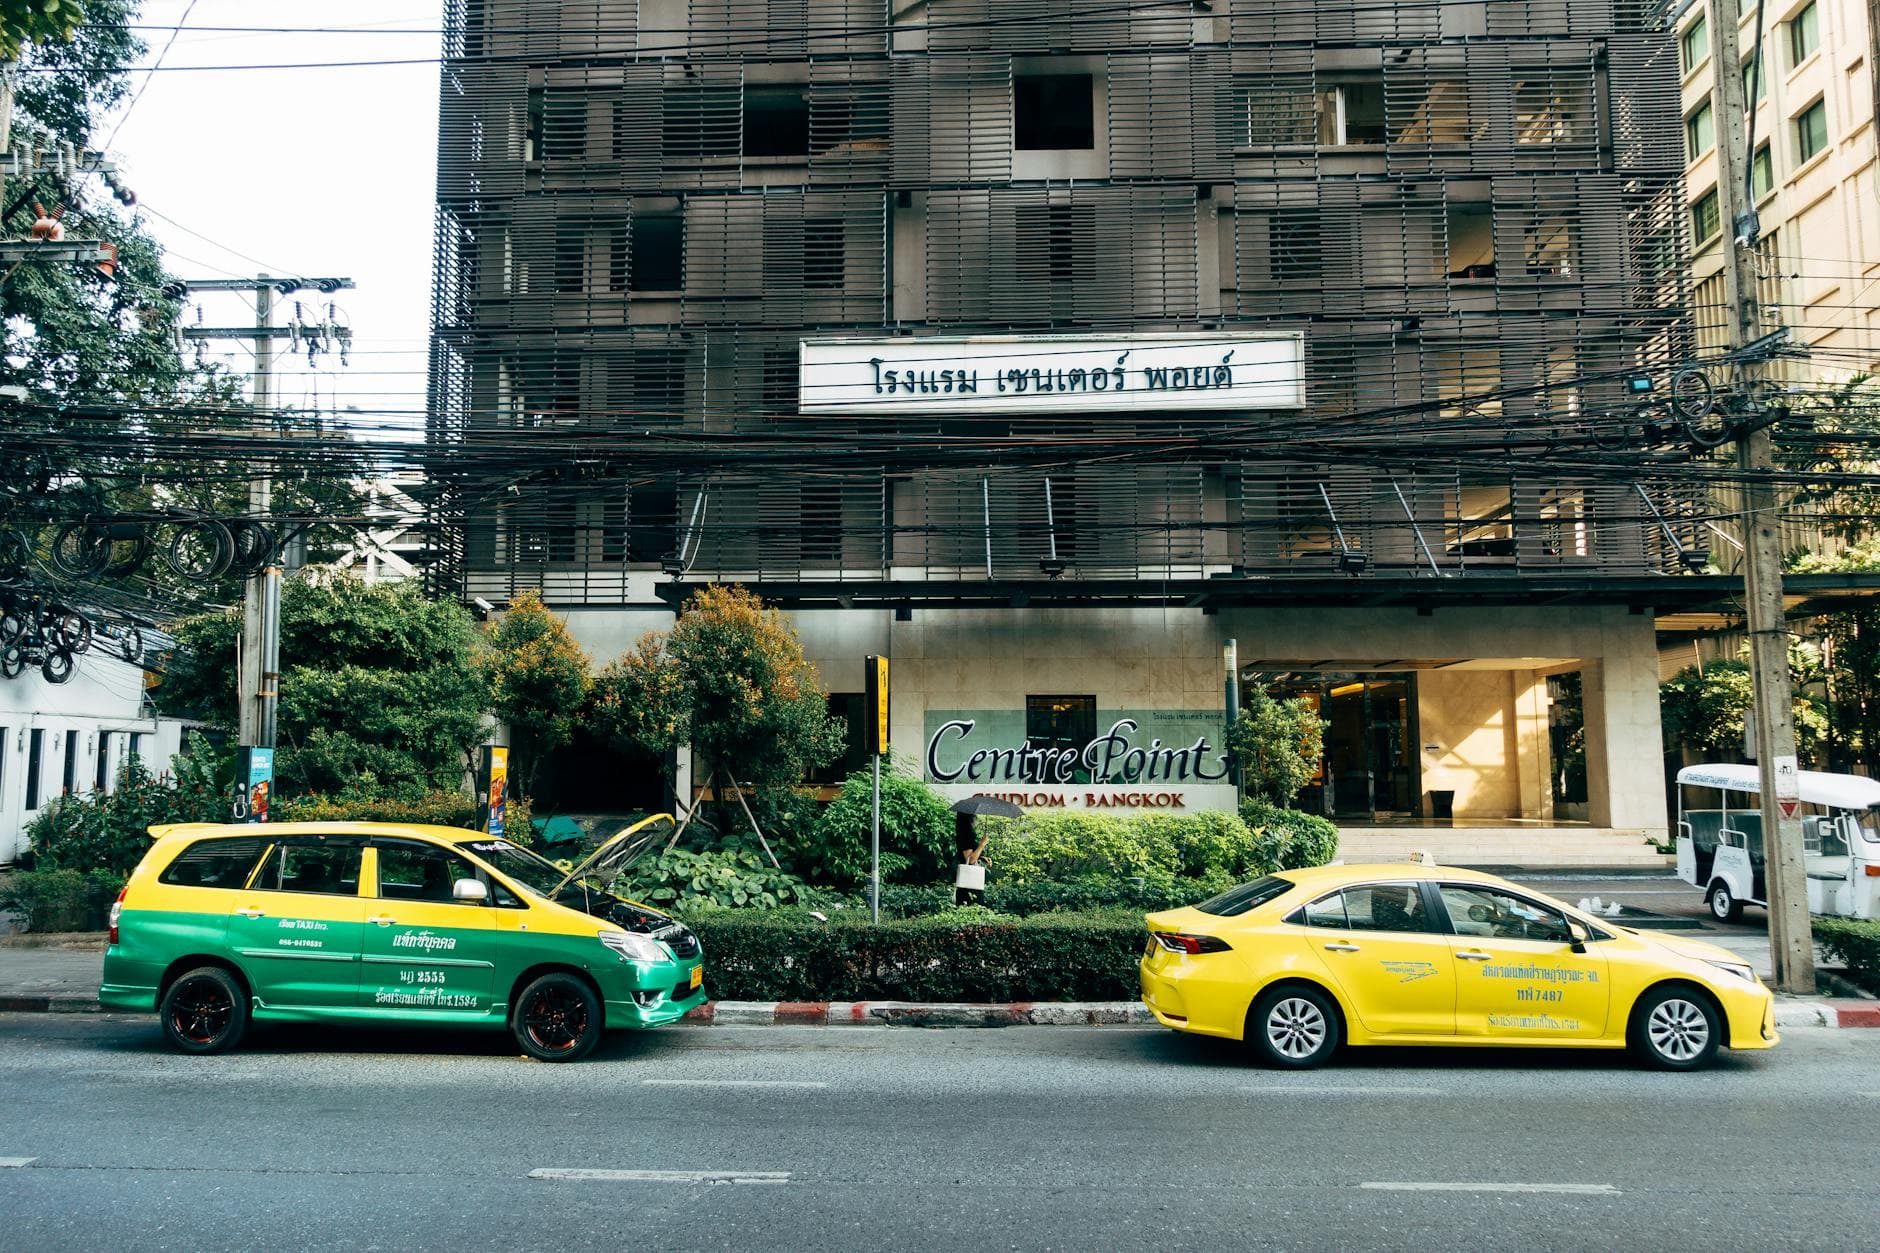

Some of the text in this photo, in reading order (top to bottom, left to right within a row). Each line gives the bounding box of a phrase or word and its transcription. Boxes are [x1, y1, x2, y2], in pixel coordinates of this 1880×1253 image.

[871, 349, 1235, 395] โรงแรม เซนเตอร์ พอยต์
[927, 719, 1079, 783] Centre
[1081, 718, 1230, 782] Point
[1085, 792, 1186, 808] BANGKOK
[296, 919, 315, 930] TAXI
[417, 970, 446, 984] 2555
[1535, 989, 1563, 1002] 7487
